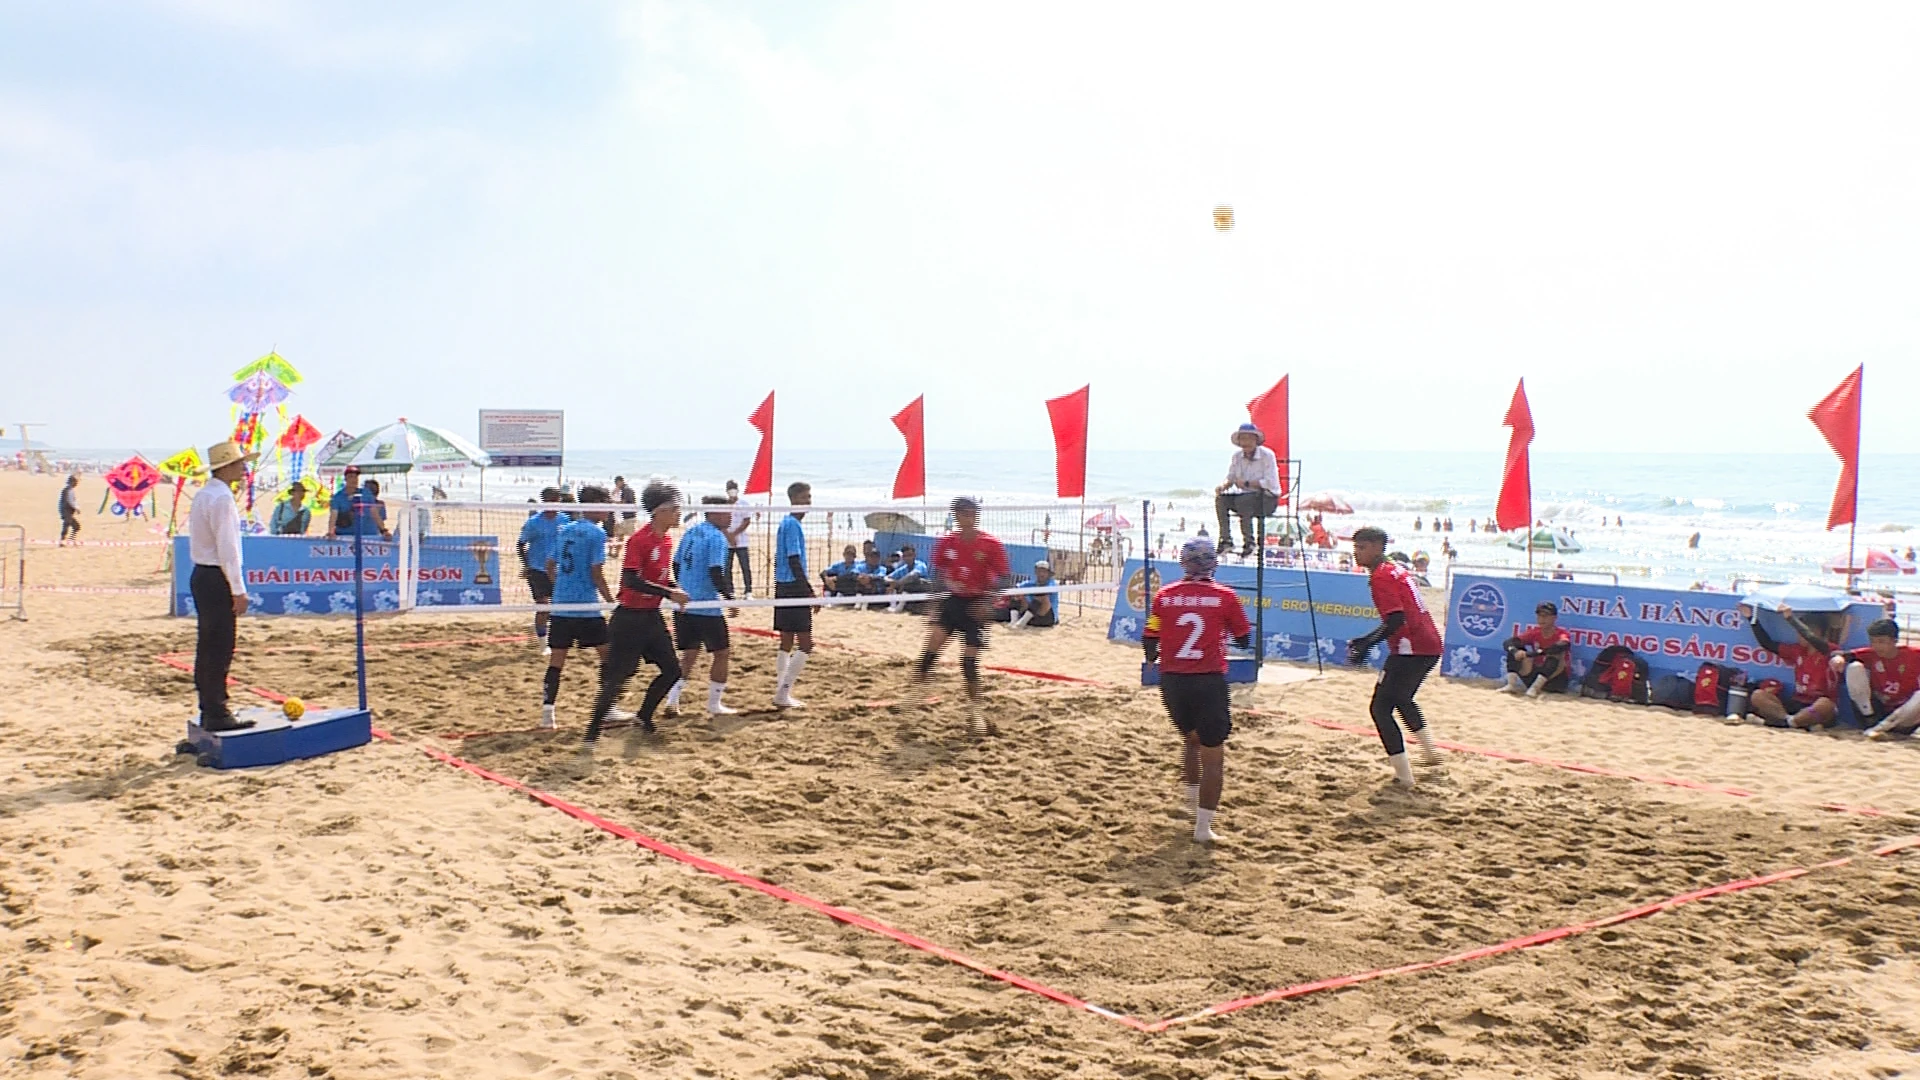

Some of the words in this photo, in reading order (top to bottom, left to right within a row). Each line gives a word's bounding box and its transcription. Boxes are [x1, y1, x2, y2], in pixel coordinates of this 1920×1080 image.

[562, 540, 575, 574] 5
[1559, 595, 1632, 620] NHÀ
[1639, 599, 1744, 629] HÀNG
[1175, 612, 1205, 660] 2
[1568, 627, 1659, 654] TRANG
